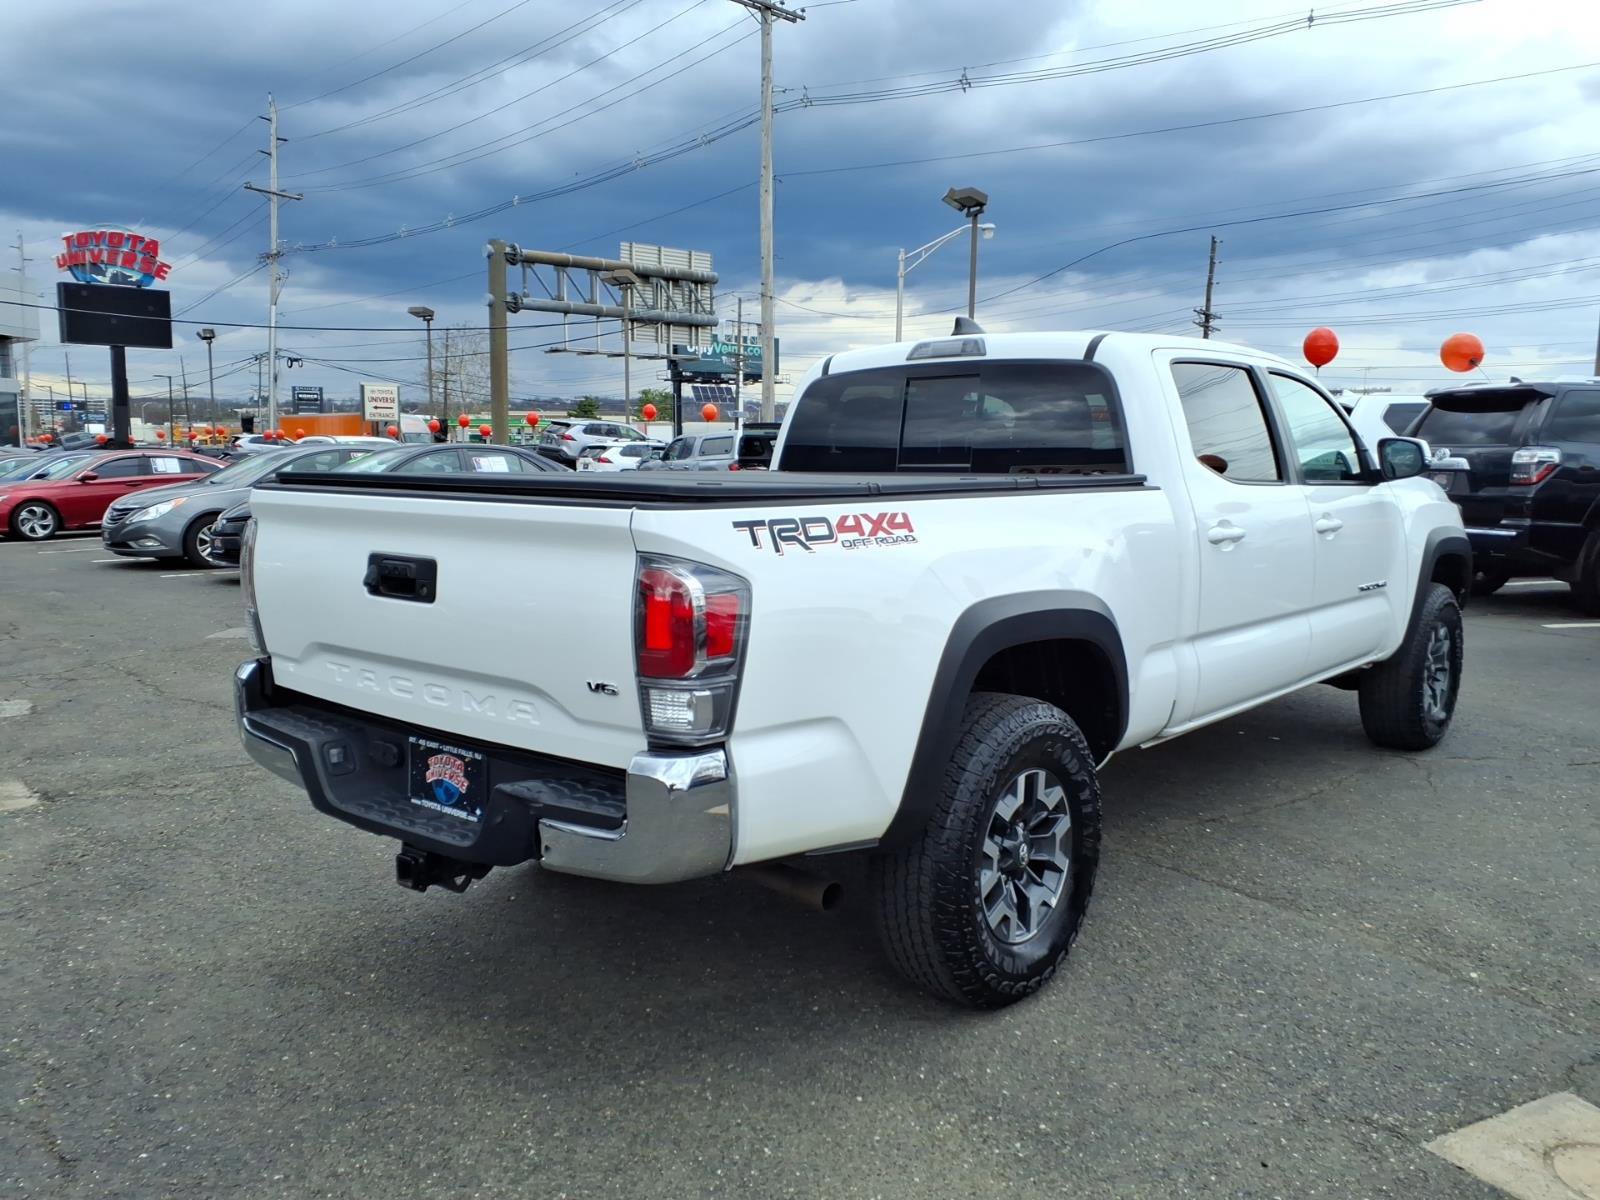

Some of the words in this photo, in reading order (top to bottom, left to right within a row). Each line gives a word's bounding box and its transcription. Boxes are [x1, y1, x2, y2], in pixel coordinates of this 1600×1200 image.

[62, 231, 159, 257] TOYOTA
[56, 249, 172, 281] UNIVERSE
[368, 396, 395, 404] UNIVERSE
[732, 516, 838, 556] TRD
[841, 537, 875, 549] OFF
[875, 533, 918, 549] ROAD
[326, 661, 541, 726] TACOMA
[586, 680, 620, 697] V6
[443, 745, 457, 754] LITTLE
[428, 754, 465, 773] TOYOTA
[426, 769, 470, 793] UNIVERSE
